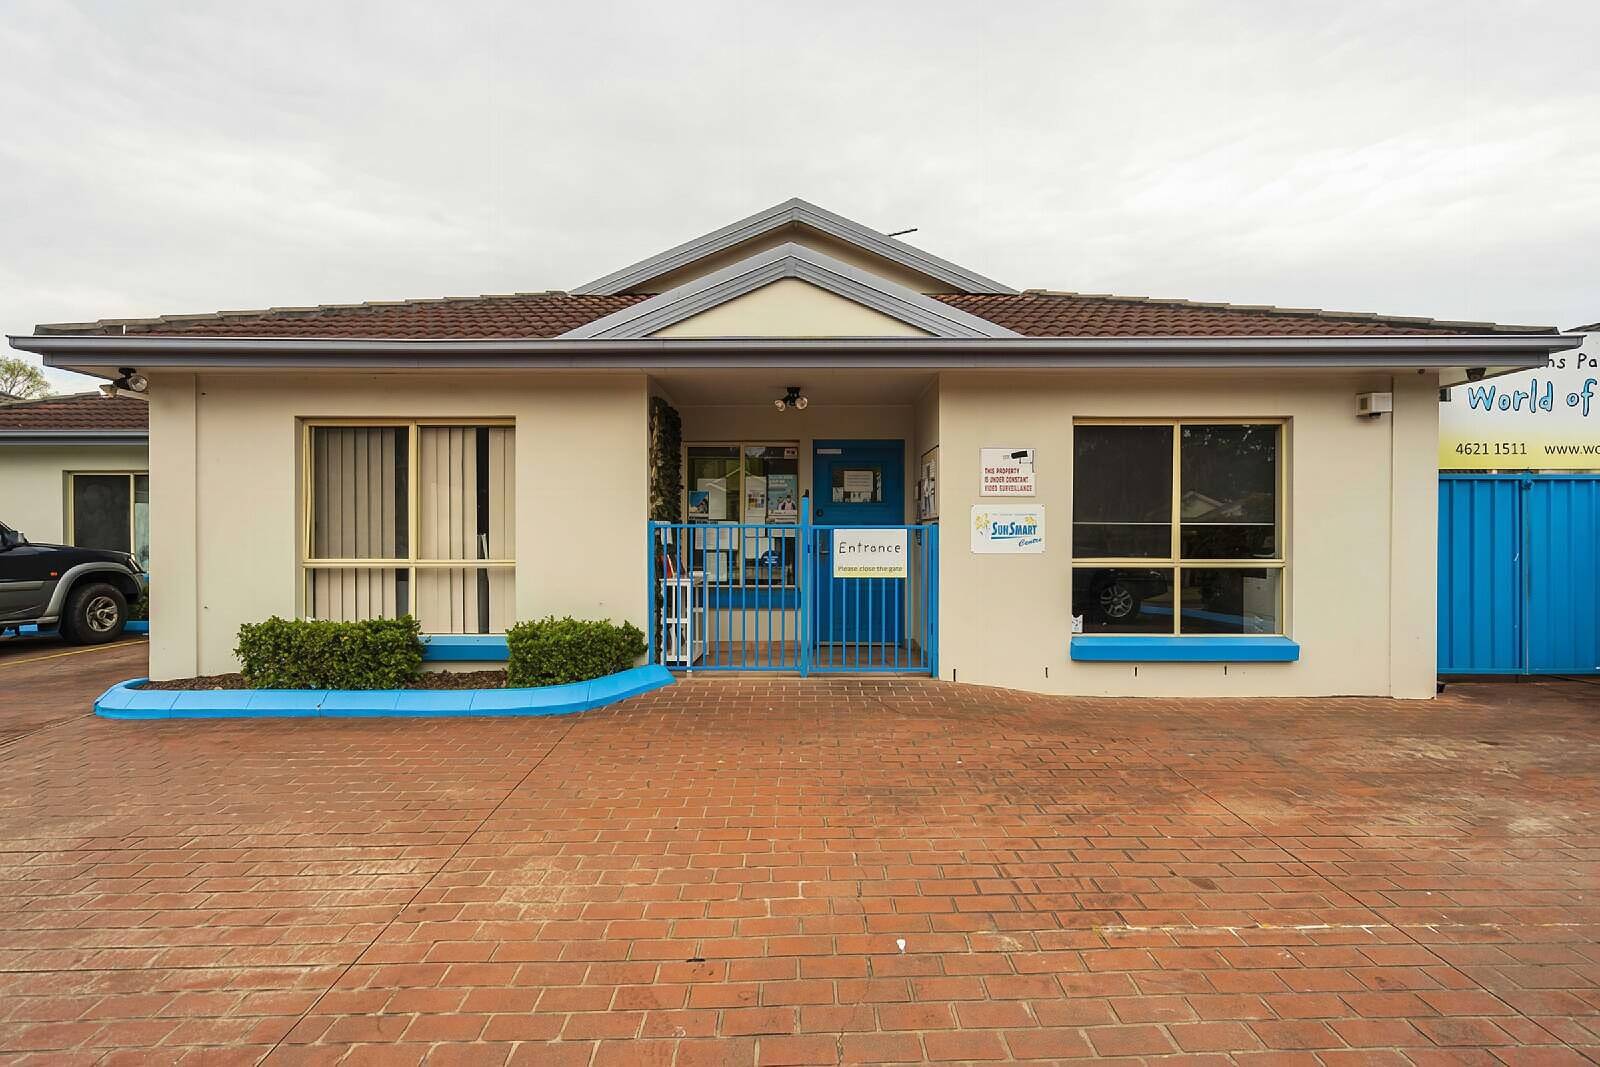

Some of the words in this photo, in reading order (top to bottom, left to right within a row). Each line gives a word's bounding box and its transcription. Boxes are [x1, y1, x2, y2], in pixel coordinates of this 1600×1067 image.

[1467, 379, 1553, 413] World
[1566, 378, 1597, 416] of
[1455, 443, 1489, 455] 4621
[1494, 443, 1527, 455] 1511
[839, 541, 901, 554] Entrance
